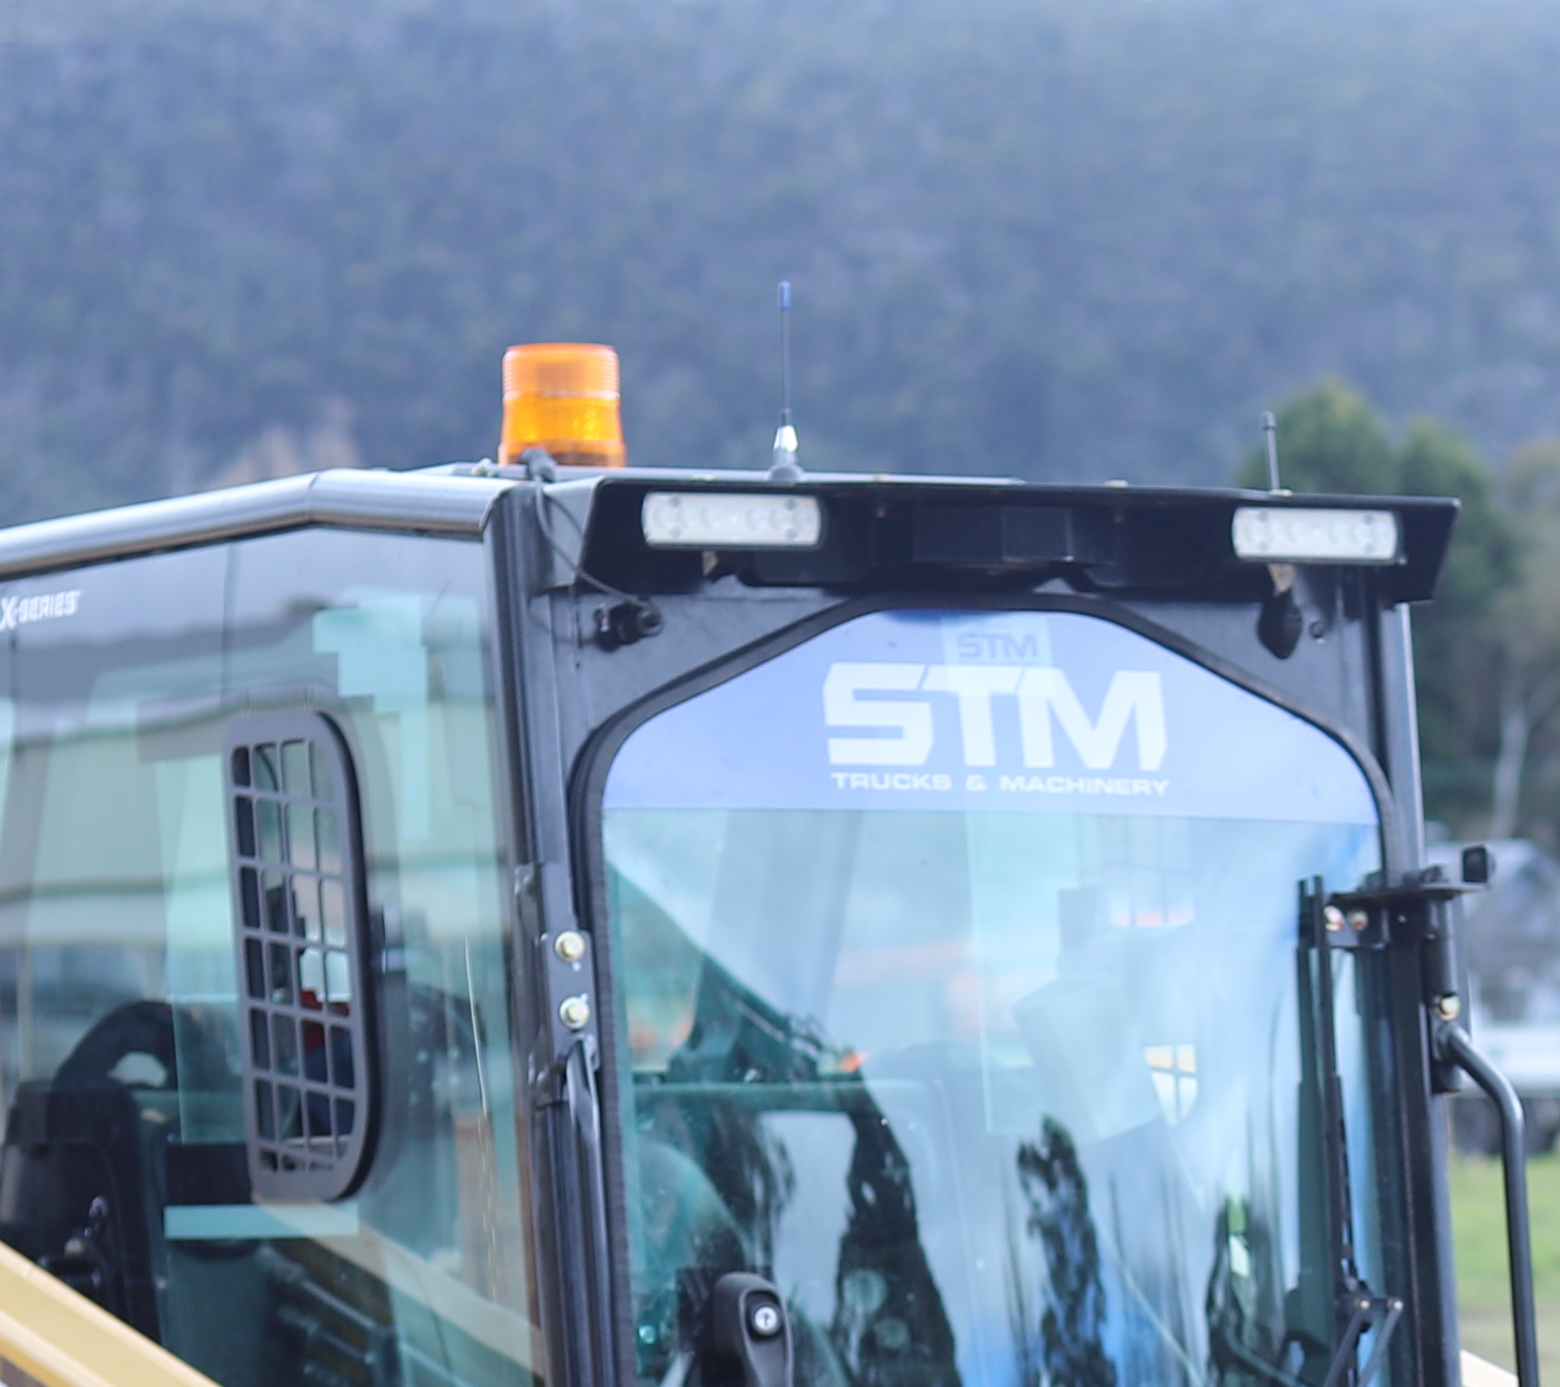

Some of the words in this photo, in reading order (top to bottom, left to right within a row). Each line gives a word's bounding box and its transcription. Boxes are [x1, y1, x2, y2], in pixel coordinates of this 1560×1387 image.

[822, 661, 1168, 772] STM
[830, 772, 952, 792] TRUCKS
[965, 773, 988, 792] &
[999, 775, 1171, 796] MACHINERY
